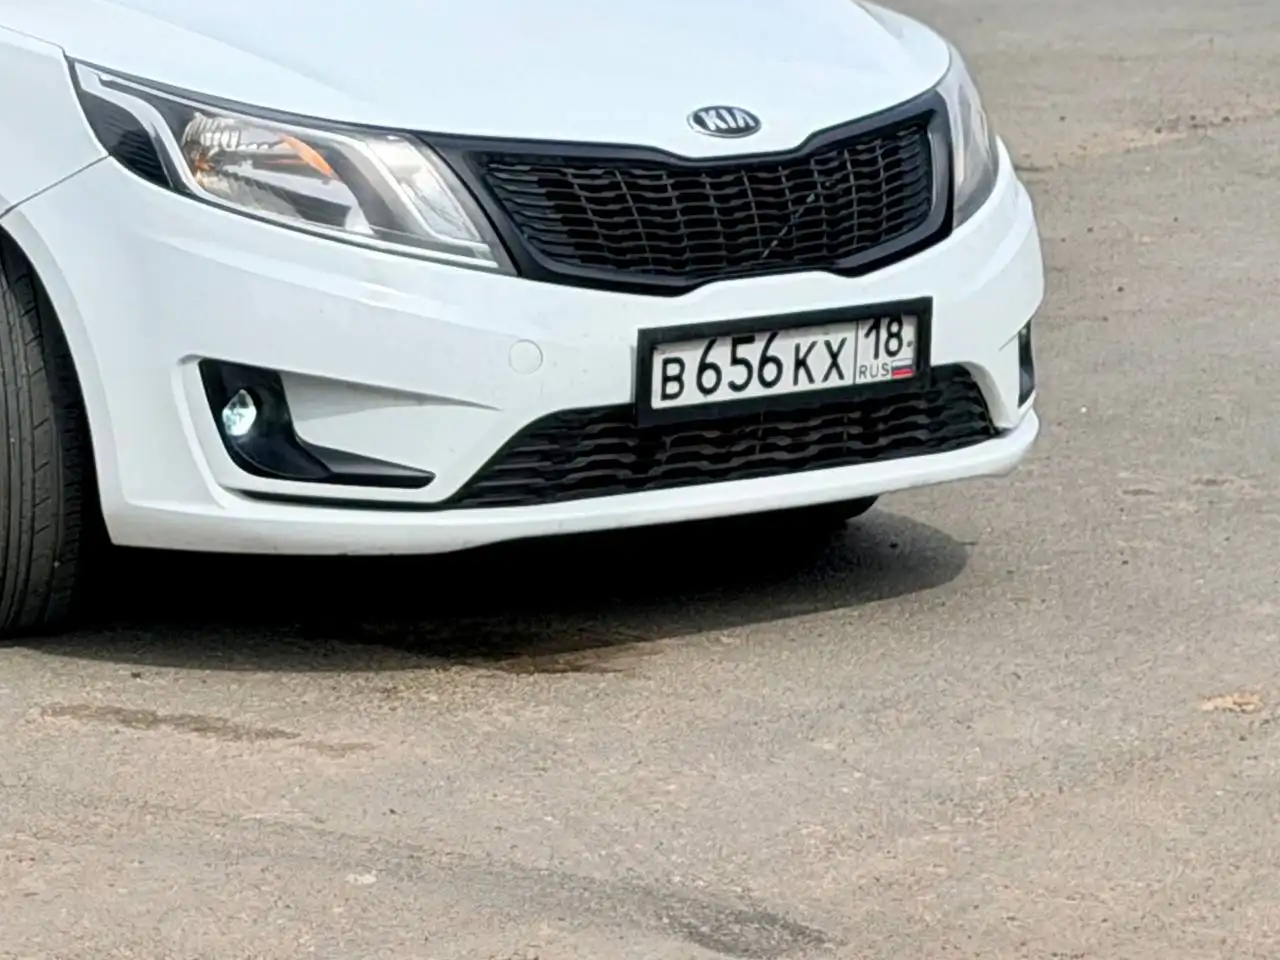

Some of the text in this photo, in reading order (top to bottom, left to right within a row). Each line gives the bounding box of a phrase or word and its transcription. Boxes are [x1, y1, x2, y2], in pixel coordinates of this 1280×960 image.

[698, 108, 756, 131] KIA
[864, 316, 904, 360] 18
[859, 362, 890, 379] RUS
